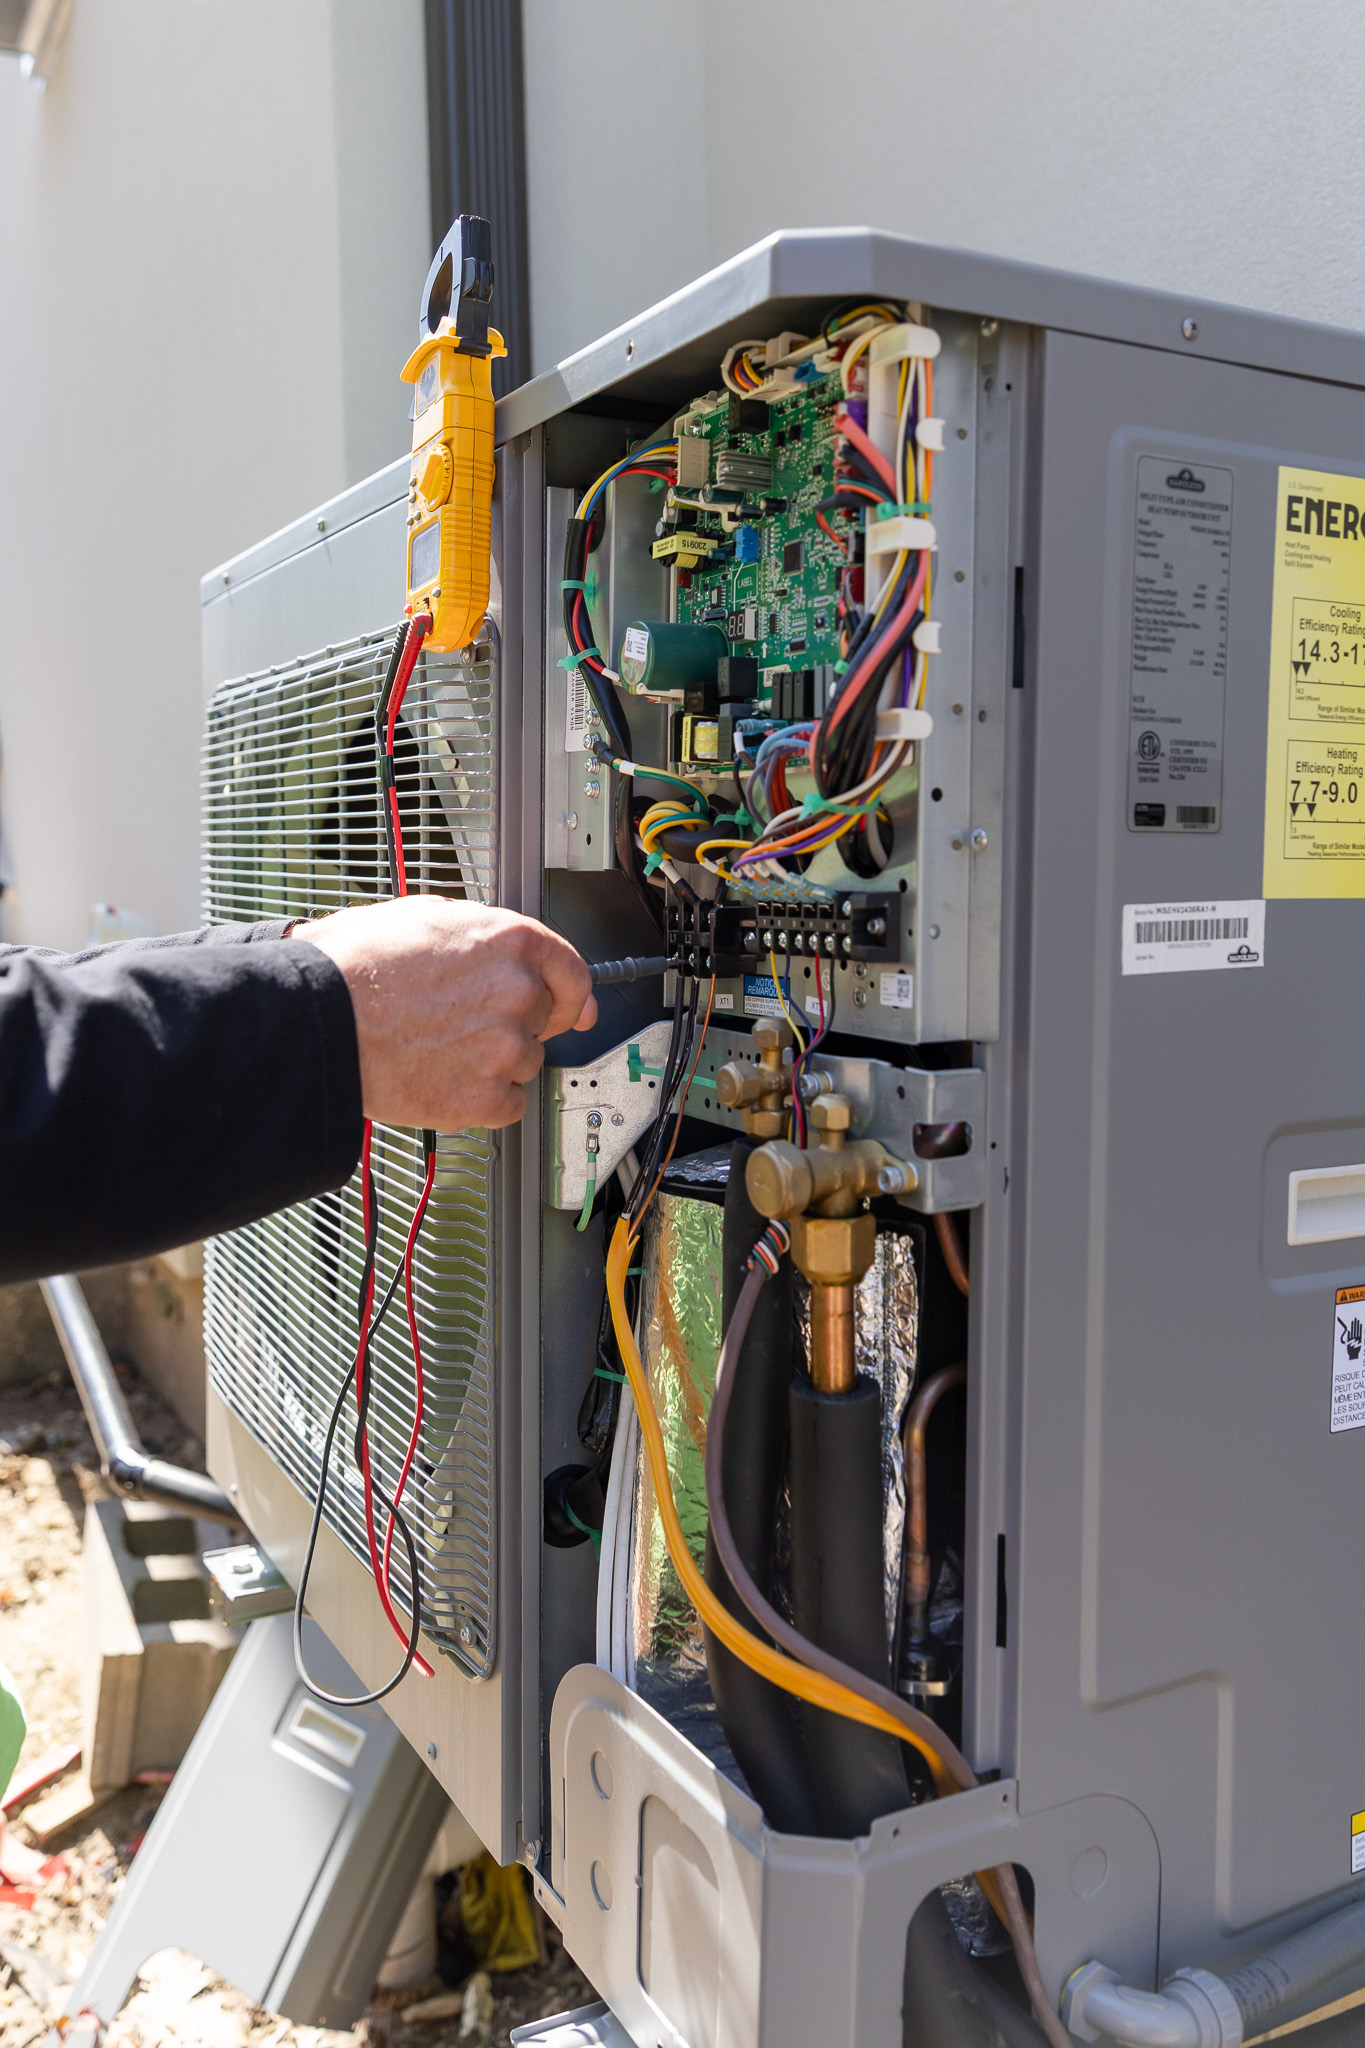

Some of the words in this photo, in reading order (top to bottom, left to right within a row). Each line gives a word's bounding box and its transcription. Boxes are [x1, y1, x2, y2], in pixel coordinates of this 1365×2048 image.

[1286, 495, 1365, 541] ENER
[682, 539, 707, 551] 230915
[1285, 550, 1303, 560] Cooling
[1314, 554, 1331, 564] Heating
[1297, 560, 1314, 569] System
[738, 577, 753, 588] LABEL
[1330, 605, 1362, 622] Cooling
[1299, 618, 1340, 636] Efficiency
[1298, 638, 1365, 666] 14.3-1
[1318, 704, 1332, 713] Range
[1327, 747, 1358, 762] Heating
[1296, 761, 1336, 777] Efficiency
[1338, 764, 1363, 778] Rating
[1291, 780, 1358, 804] 7.7-9.0
[1312, 842, 1328, 851] Range
[670, 933, 676, 943] L1
[685, 934, 692, 944] L2
[755, 978, 776, 988] NOTIC
[719, 997, 729, 1005] XT1
[811, 1001, 821, 1011] XT
[1335, 1371, 1360, 1383] RISQUE
[1335, 1383, 1351, 1393] PEUT
[1334, 1393, 1352, 1404] MÊME
[1334, 1405, 1346, 1414] LES
